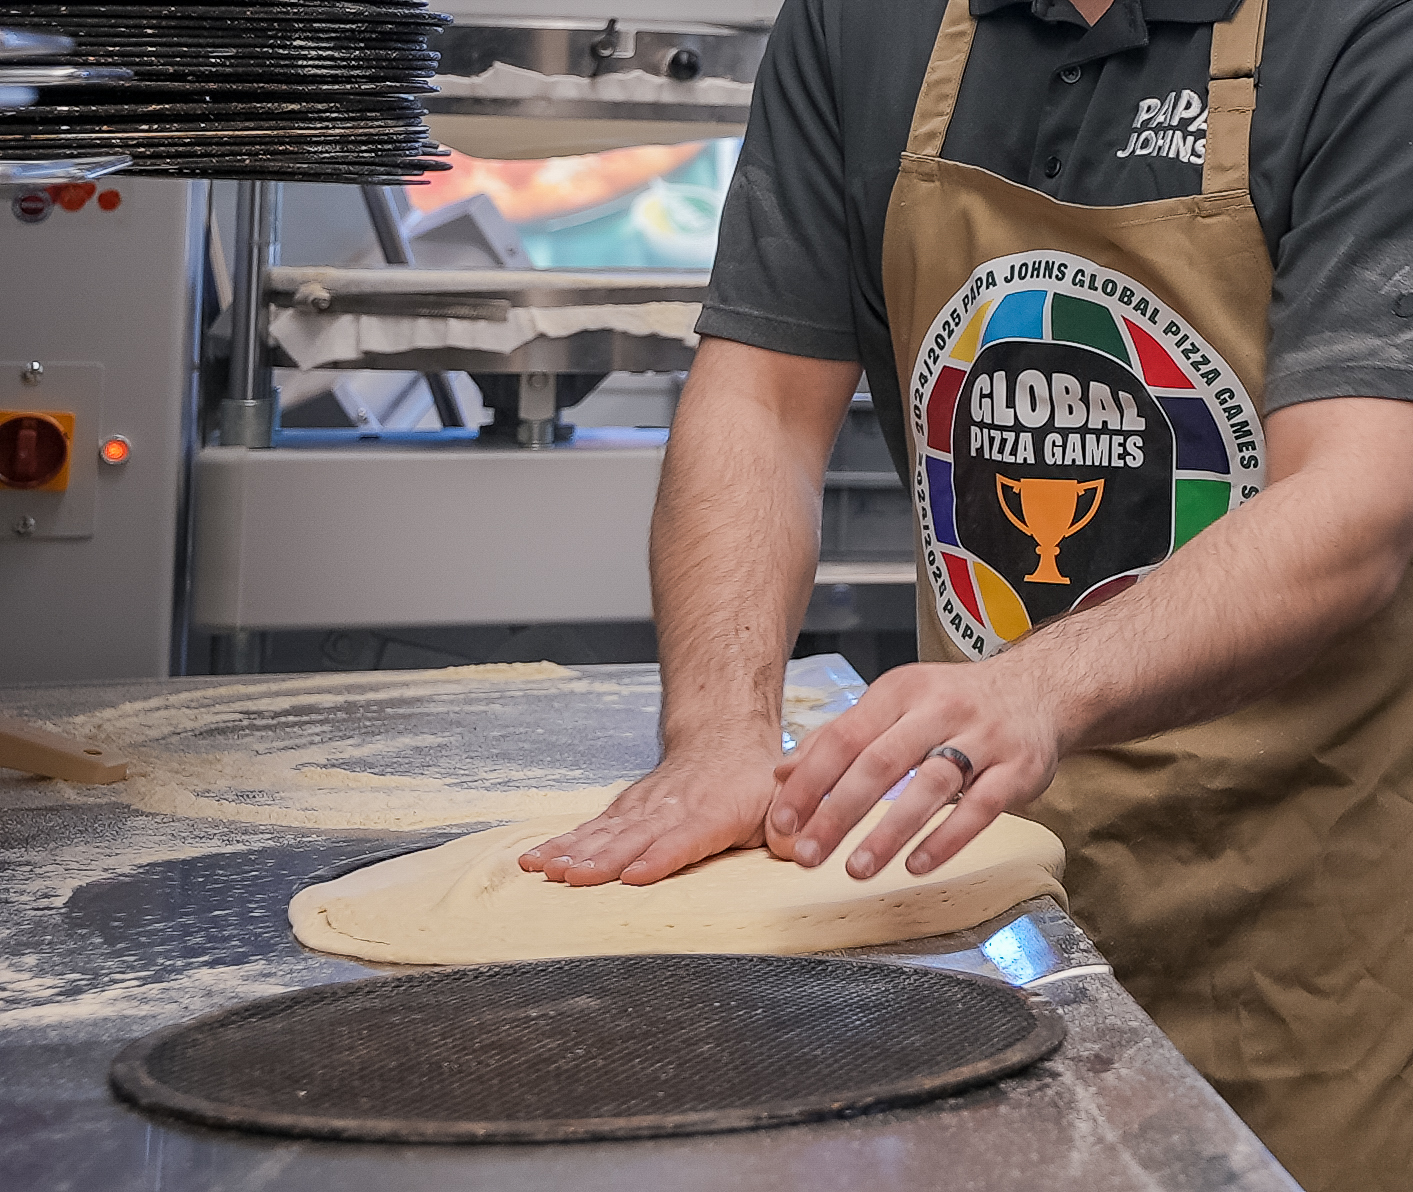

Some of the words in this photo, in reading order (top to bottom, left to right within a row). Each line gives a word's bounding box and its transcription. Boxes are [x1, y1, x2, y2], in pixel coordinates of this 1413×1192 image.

[914, 308, 963, 438] 2024/2025
[961, 270, 997, 315] PAPA
[1003, 259, 1069, 286] JOHNS
[1071, 269, 1162, 327] GLOBAL
[1162, 319, 1221, 388] PIZZA
[1215, 386, 1260, 471] GAMES
[969, 368, 1147, 432] GLOBAL
[969, 425, 1036, 466] PIZZA
[1043, 433, 1145, 469] GAMES
[942, 600, 987, 656] PAPA
